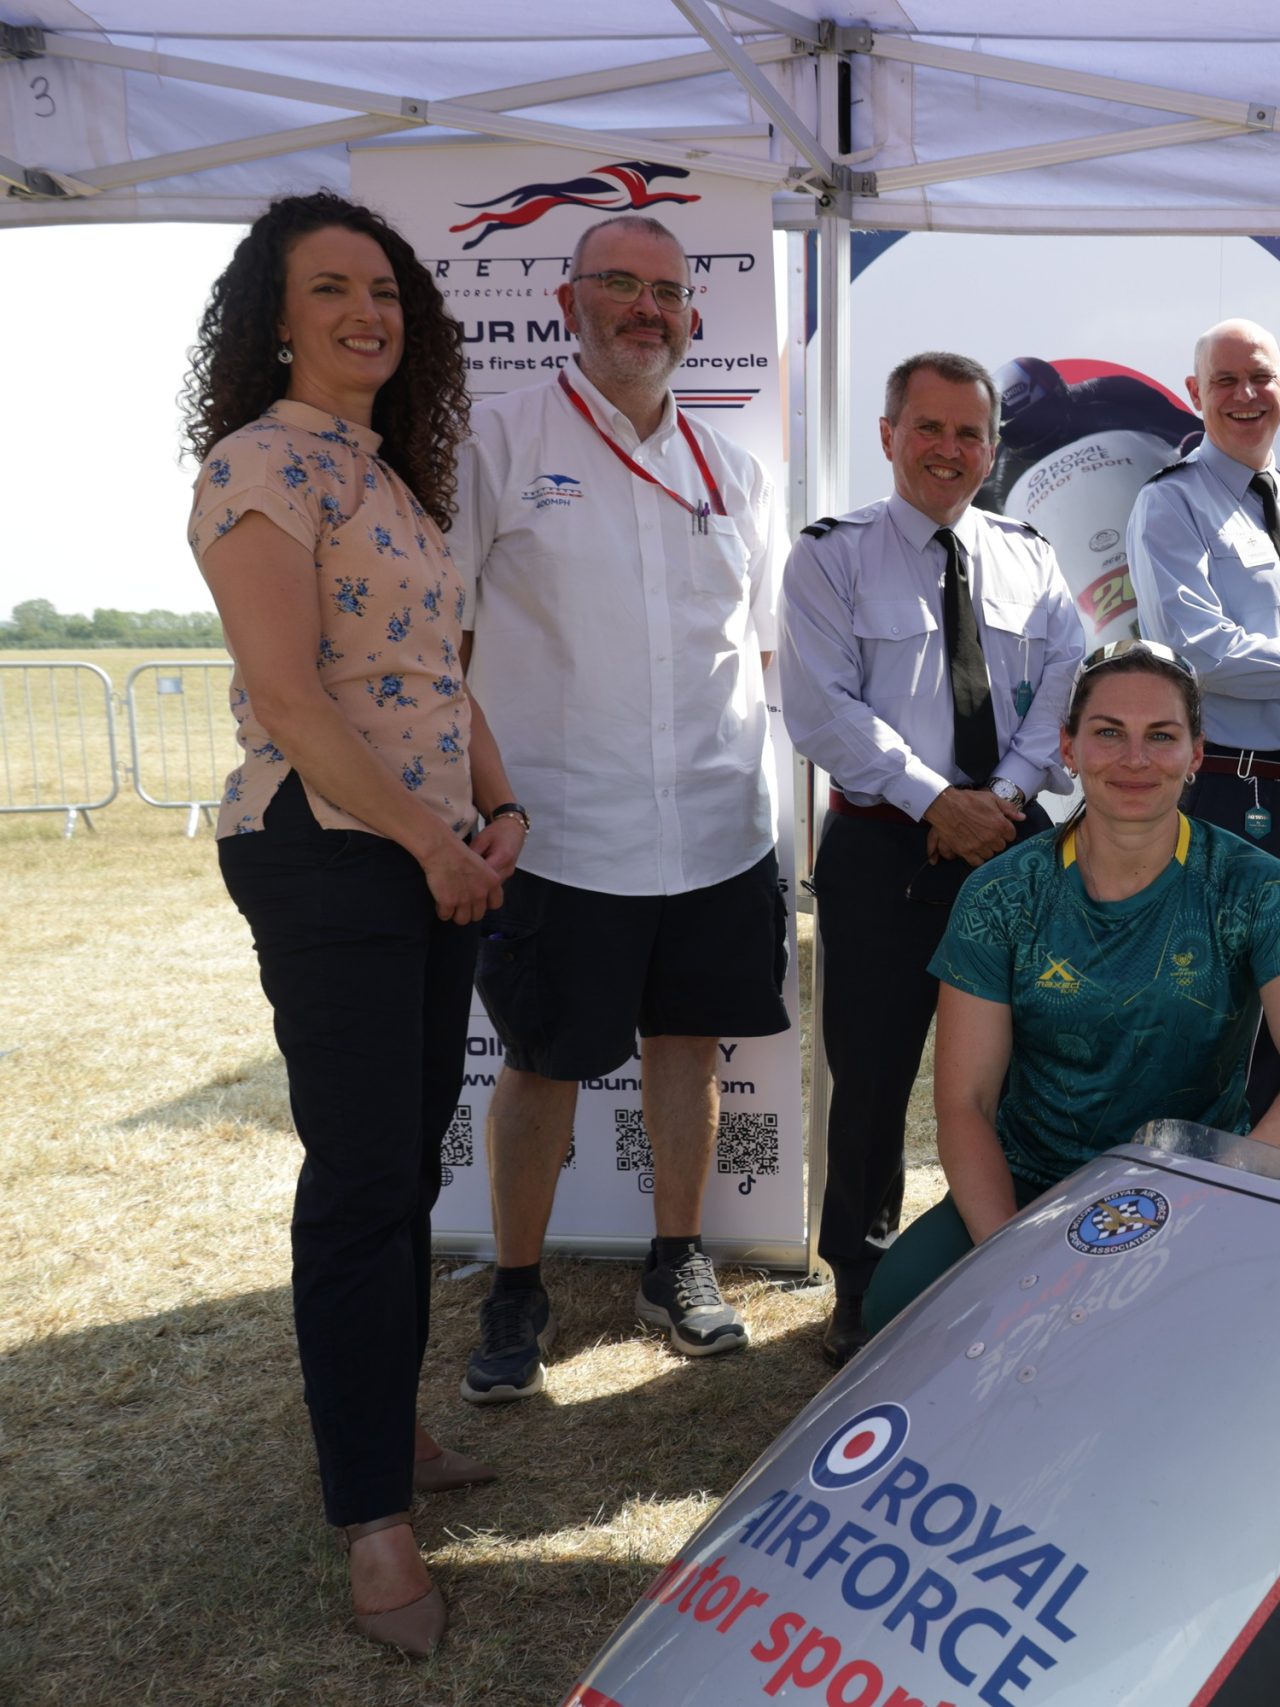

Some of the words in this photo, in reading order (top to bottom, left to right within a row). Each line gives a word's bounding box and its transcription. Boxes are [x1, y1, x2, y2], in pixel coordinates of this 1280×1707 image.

[29, 76, 56, 117] 3
[435, 253, 756, 279] REYND
[444, 289, 534, 298] OTORCYCLE
[459, 320, 516, 343] UR
[491, 356, 536, 370] first
[680, 353, 769, 372] orcycle
[1048, 444, 1108, 472] ROYAL
[1026, 479, 1051, 505] AIR
[1051, 450, 1110, 480] FORCE
[1027, 474, 1072, 515] motor
[1081, 456, 1134, 474] sport
[1103, 1189, 1137, 1203] ROYAL
[1140, 1189, 1157, 1199] AIR
[1154, 1197, 1167, 1221] FORCE
[1069, 1230, 1091, 1252] SPORTS
[1090, 1228, 1157, 1254] ASSOCIATION
[861, 1456, 1089, 1645] ROYAL
[737, 1489, 831, 1569] AIR
[803, 1520, 1058, 1707] FORCE
[750, 1611, 957, 1707] spo
